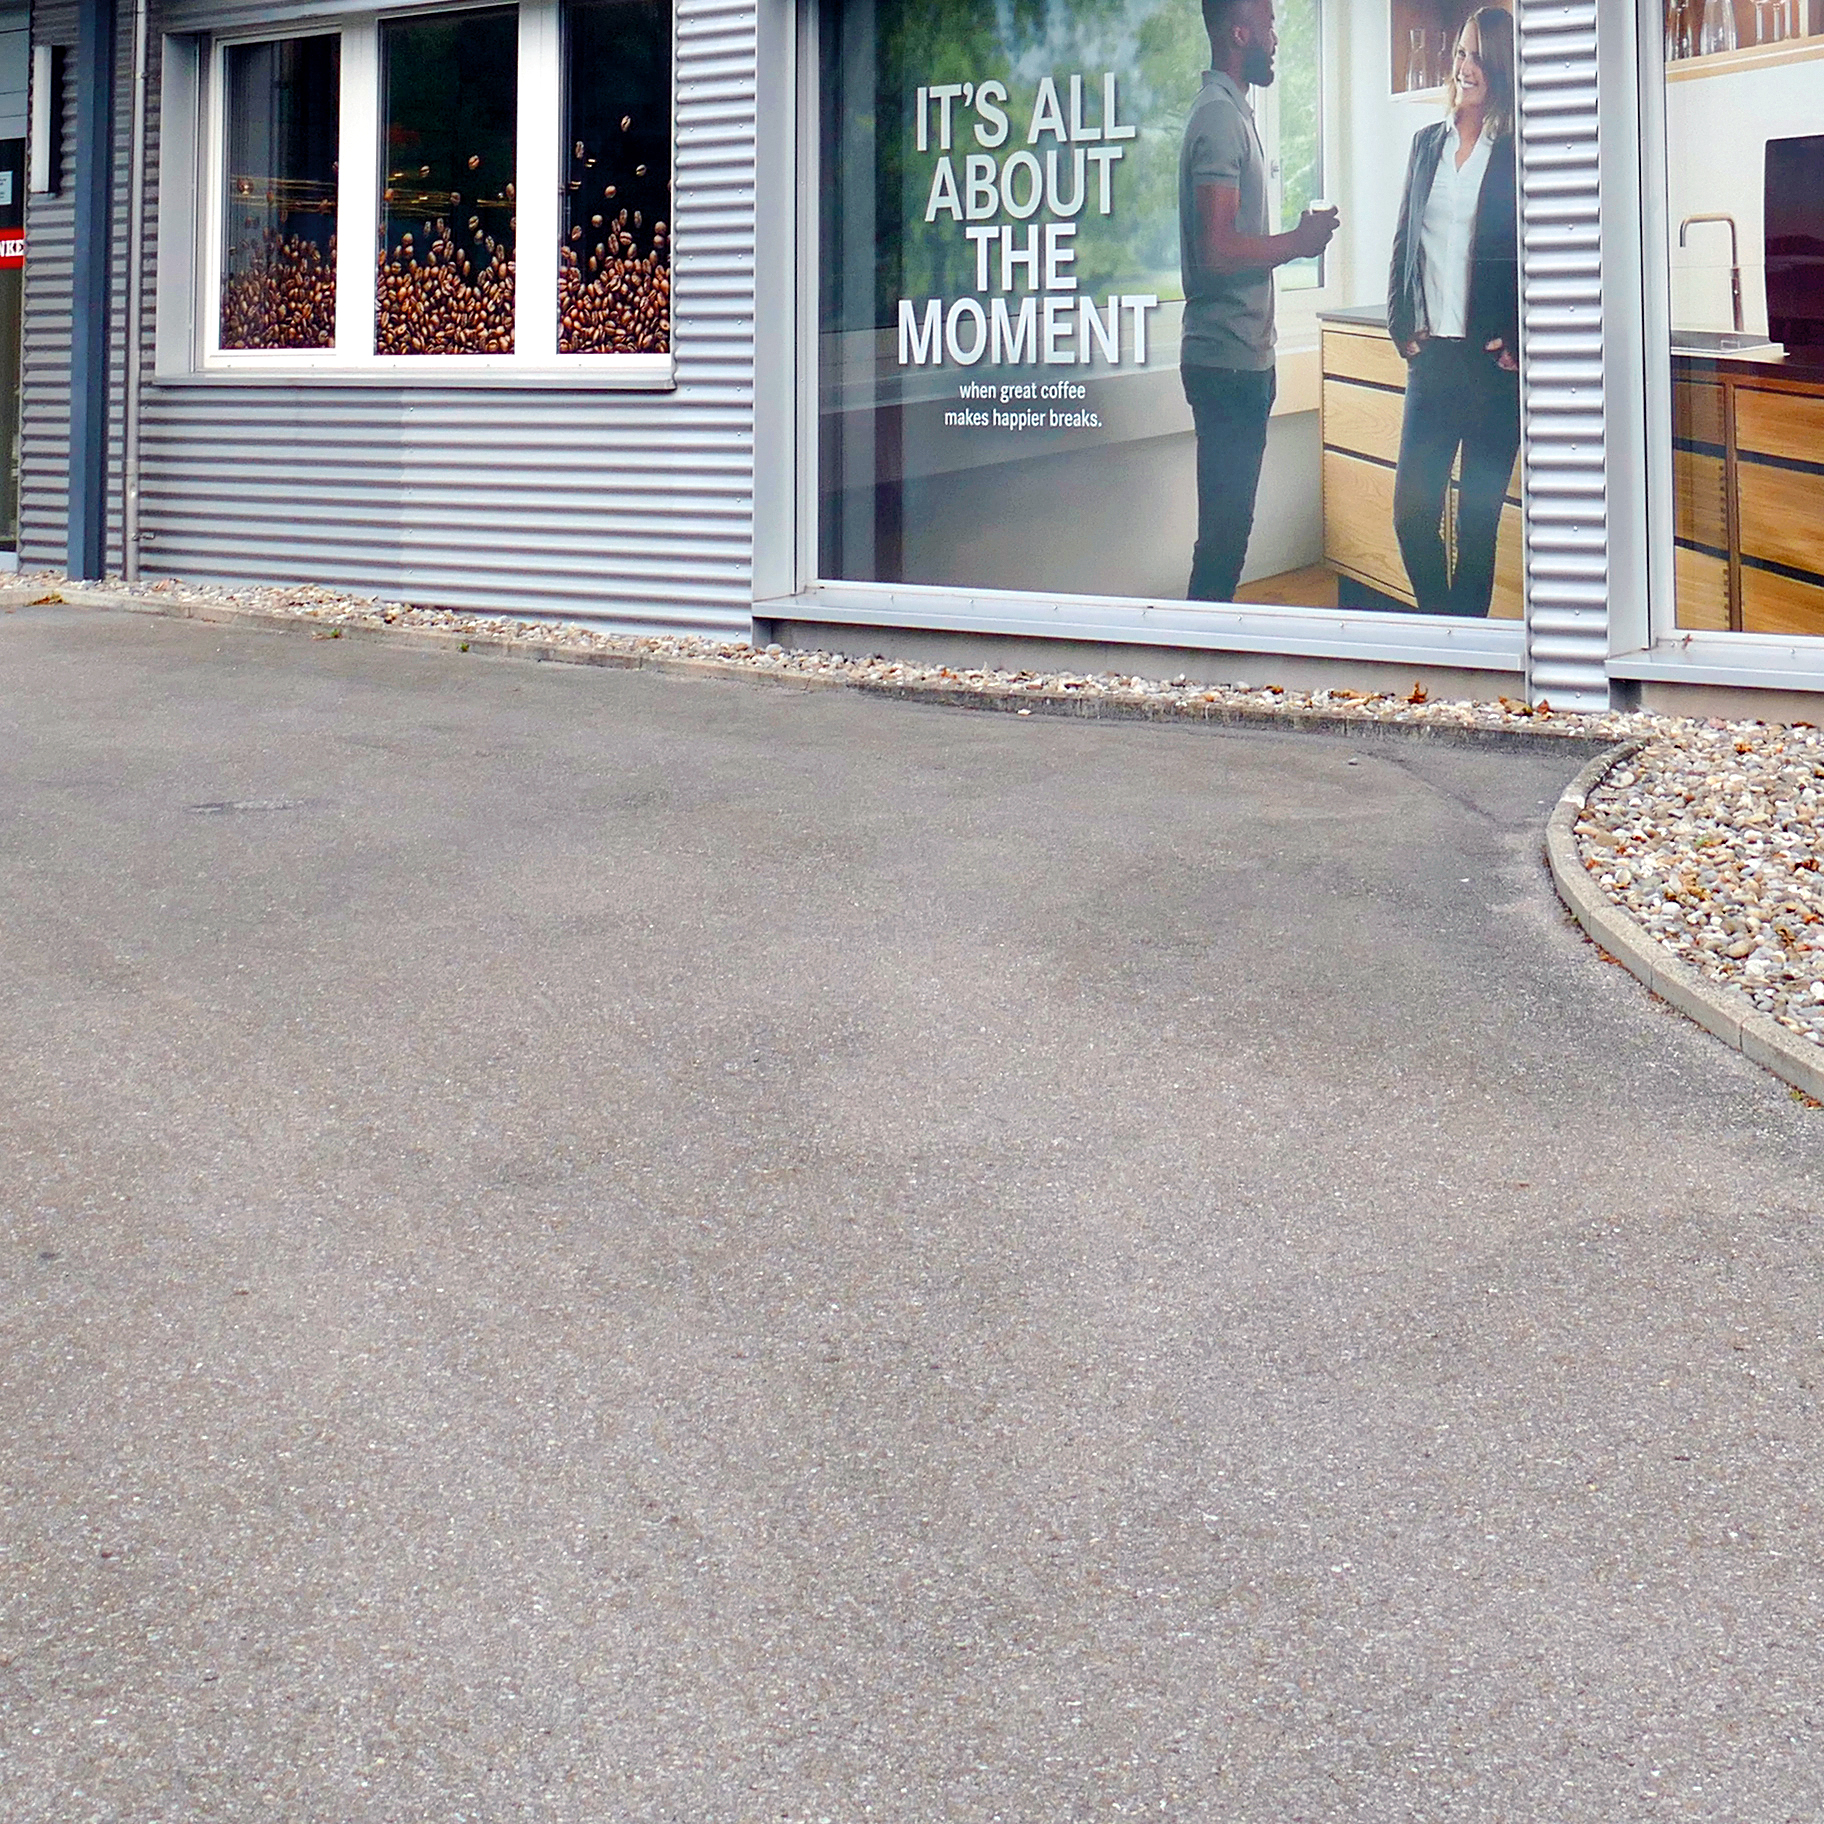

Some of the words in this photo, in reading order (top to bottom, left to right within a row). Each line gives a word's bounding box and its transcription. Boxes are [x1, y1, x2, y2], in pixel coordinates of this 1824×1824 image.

[916, 79, 1009, 152] IT'S
[1027, 72, 1136, 144] ALL
[925, 146, 1123, 222] ABOUT
[965, 222, 1077, 292] THE
[898, 294, 1158, 366] MOMENT
[944, 408, 989, 426] makes
[992, 408, 1046, 430] happier
[1049, 408, 1102, 427] breaks.
[959, 381, 996, 399] when
[1000, 382, 1037, 403] great
[1040, 381, 1086, 399] coffee
